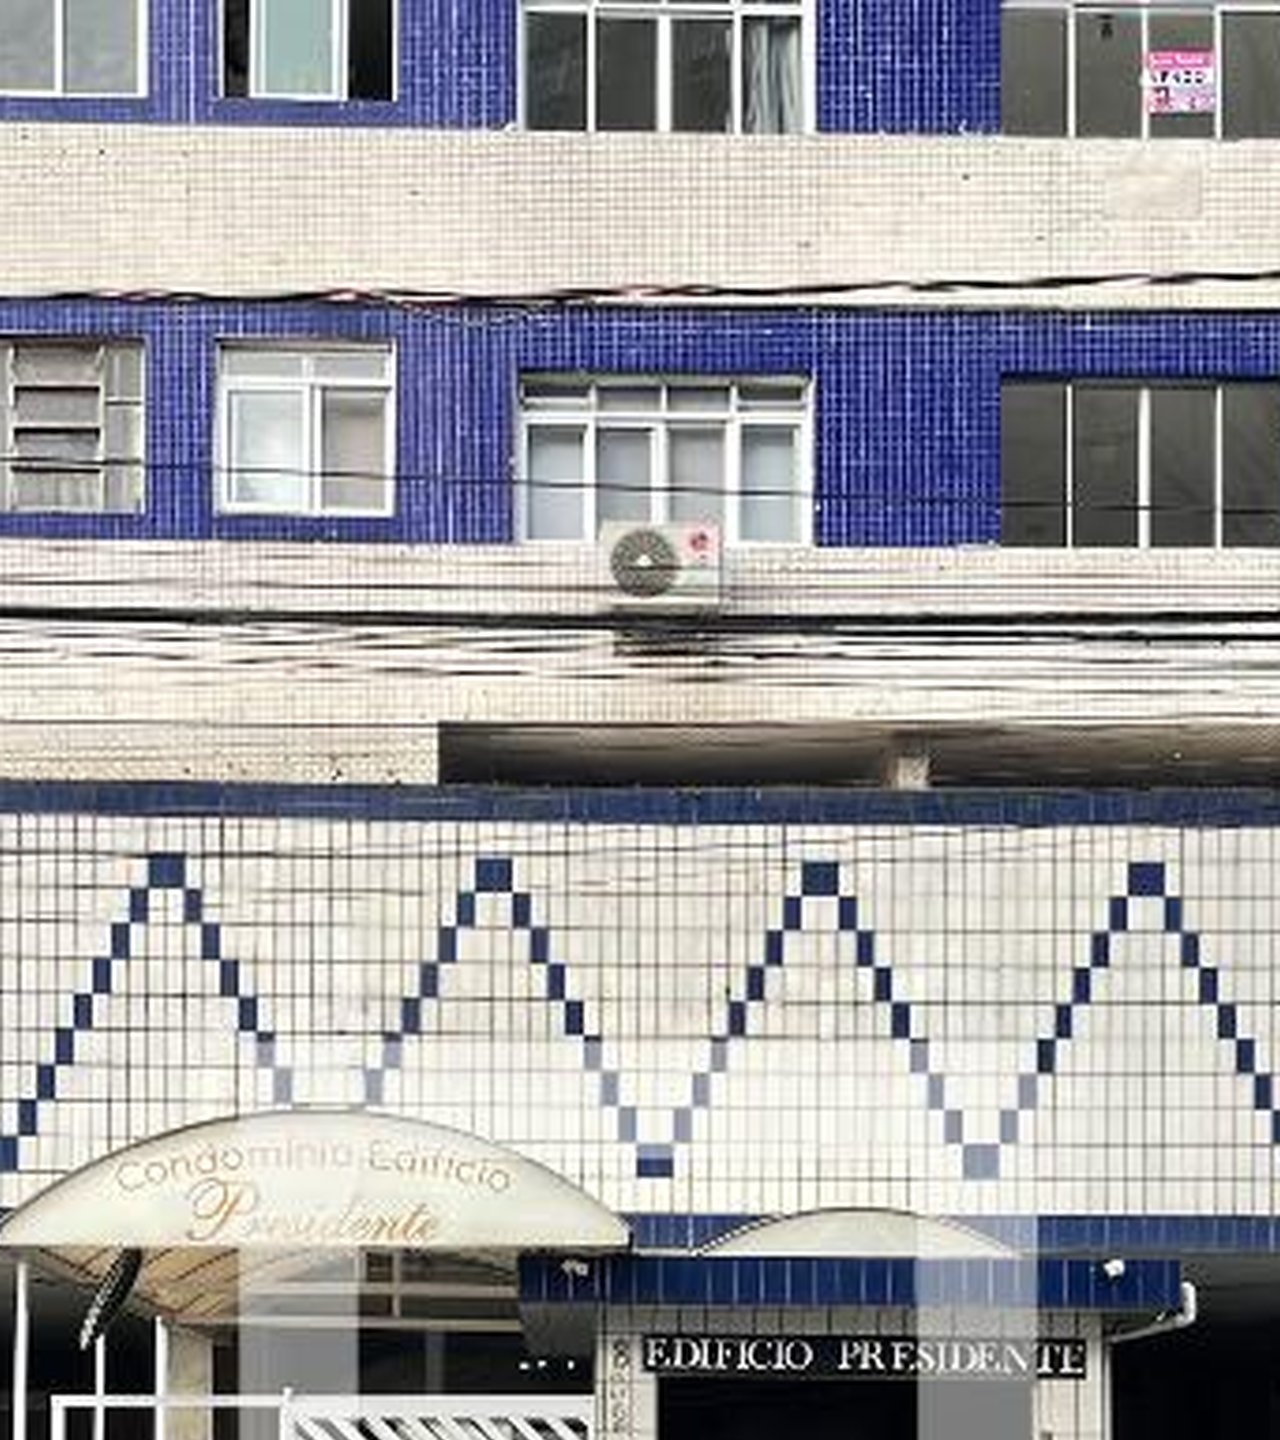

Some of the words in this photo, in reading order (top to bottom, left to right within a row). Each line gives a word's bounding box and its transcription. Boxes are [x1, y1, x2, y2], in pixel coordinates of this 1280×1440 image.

[185, 1177, 439, 1242] Presidente
[646, 1337, 814, 1371] EDIFICIO
[837, 1338, 1085, 1375] PRESIDENTE
